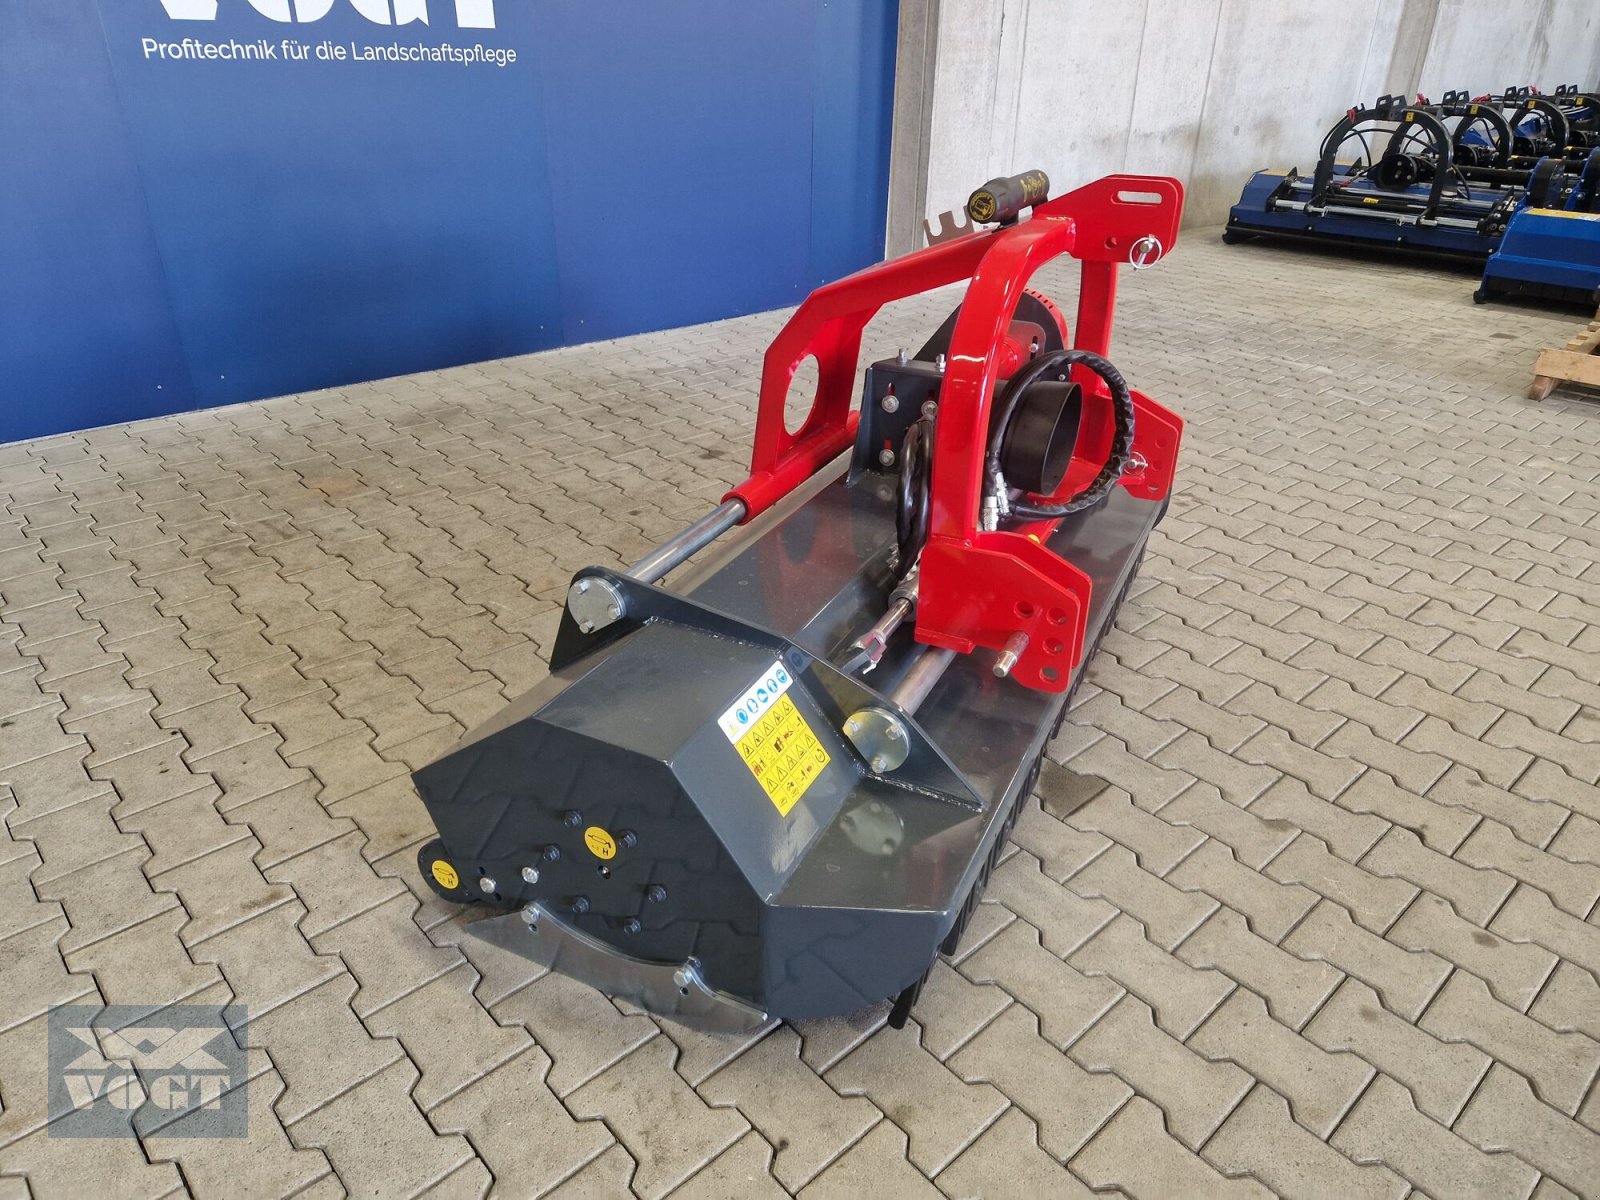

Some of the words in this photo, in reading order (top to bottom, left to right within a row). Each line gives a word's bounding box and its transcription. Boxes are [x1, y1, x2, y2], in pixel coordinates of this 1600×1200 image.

[141, 37, 278, 60] Profitechnik
[281, 39, 310, 60] für
[315, 40, 346, 61] die
[350, 41, 517, 67] Landschaftspflege
